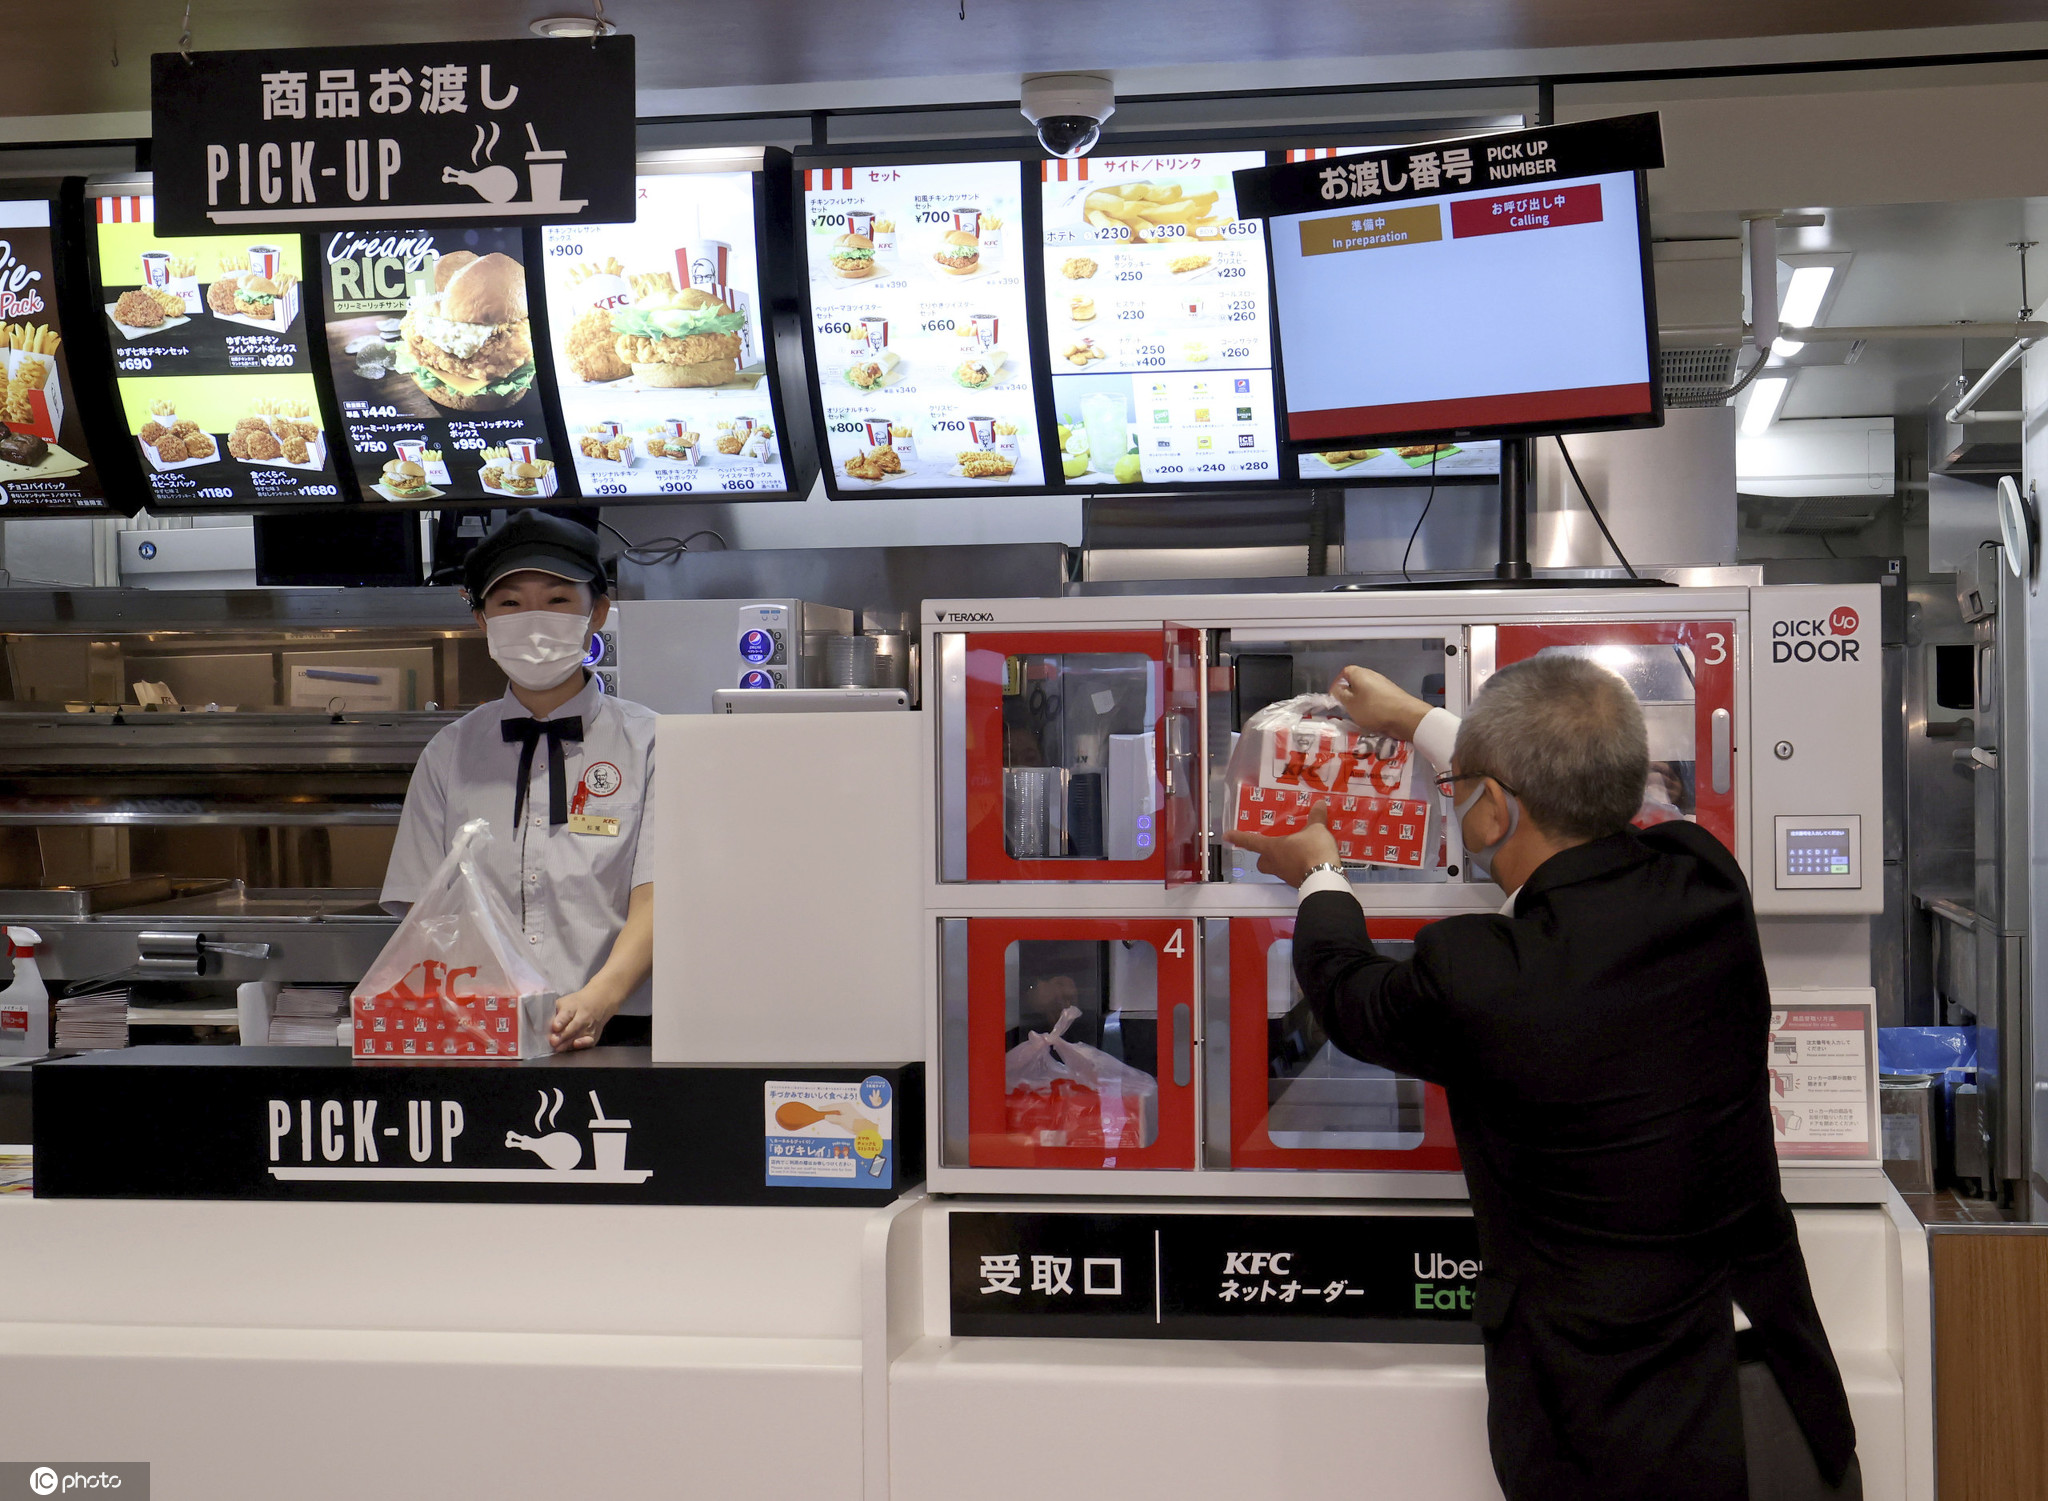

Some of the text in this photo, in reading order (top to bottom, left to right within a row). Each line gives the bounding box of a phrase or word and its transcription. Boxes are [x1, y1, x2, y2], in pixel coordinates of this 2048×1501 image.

[261, 63, 519, 120] 商品お渡し
[1487, 140, 1549, 162] PICK UP
[207, 138, 401, 206] PICK-UP
[868, 169, 901, 182] セット
[1319, 148, 1474, 200] お渡し番号
[1489, 158, 1557, 181] NUMBER
[1491, 194, 1567, 216] お呼び出し中
[811, 214, 845, 227] ¥700
[915, 211, 950, 223] ¥700
[1510, 212, 1550, 228] Calling
[1220, 222, 1257, 235] ¥650
[1351, 216, 1387, 232] 準備中
[1094, 227, 1130, 240] ¥230
[1150, 225, 1186, 238] ¥330
[1332, 230, 1408, 250] In preparation
[549, 244, 583, 256] ¥900
[330, 254, 436, 300] RICH
[1115, 271, 1143, 281] ¥250
[1217, 267, 1246, 278] ¥230
[593, 294, 630, 310] KFC
[1228, 300, 1256, 310] ¥230
[1117, 310, 1145, 320] ¥230
[1228, 311, 1256, 321] ¥260
[817, 322, 851, 334] ¥660
[921, 319, 955, 332] ¥660
[225, 335, 280, 346] ゆず七味チキン
[116, 346, 190, 357] ゆず七味チキンセット
[227, 344, 298, 355] フィレサンドボックス
[1136, 345, 1165, 355] ¥250
[1221, 347, 1250, 357] ¥260
[118, 357, 152, 371] ¥690
[260, 354, 294, 368] ¥920
[1136, 357, 1166, 366] ¥400
[362, 405, 397, 418] ¥440
[350, 423, 425, 432] クリーミーリッチサンド
[448, 419, 525, 429] クリーミーリッチサンド
[830, 422, 864, 433] ¥800
[931, 420, 965, 431] ¥760
[351, 432, 373, 440] セット
[354, 441, 388, 453] ¥750
[452, 438, 487, 450] ¥950
[1155, 465, 1183, 474] ¥200
[1197, 463, 1226, 472] ¥240
[1240, 461, 1269, 471] ¥280
[149, 472, 186, 481] 食べくらべ
[250, 470, 287, 479] 食べくらべ
[152, 479, 197, 488] 4ピースパック
[252, 477, 298, 486] 6ピースパック
[659, 481, 693, 492] ¥900
[721, 480, 755, 490] ¥860
[198, 487, 233, 498] ¥1180
[298, 485, 338, 496] ¥1680
[595, 483, 627, 495] ¥990
[947, 612, 994, 622] TERAOKA
[1704, 632, 1727, 665] 3
[1772, 639, 1860, 663] DOOR
[1163, 927, 1186, 959] 4
[268, 1099, 464, 1162] PICK-UP
[1223, 1252, 1291, 1275] KFC
[1414, 1252, 1483, 1279] Ube
[979, 1253, 1122, 1295] 受取口
[1218, 1279, 1364, 1303] ネットオーダー
[1415, 1283, 1477, 1310] Eat
